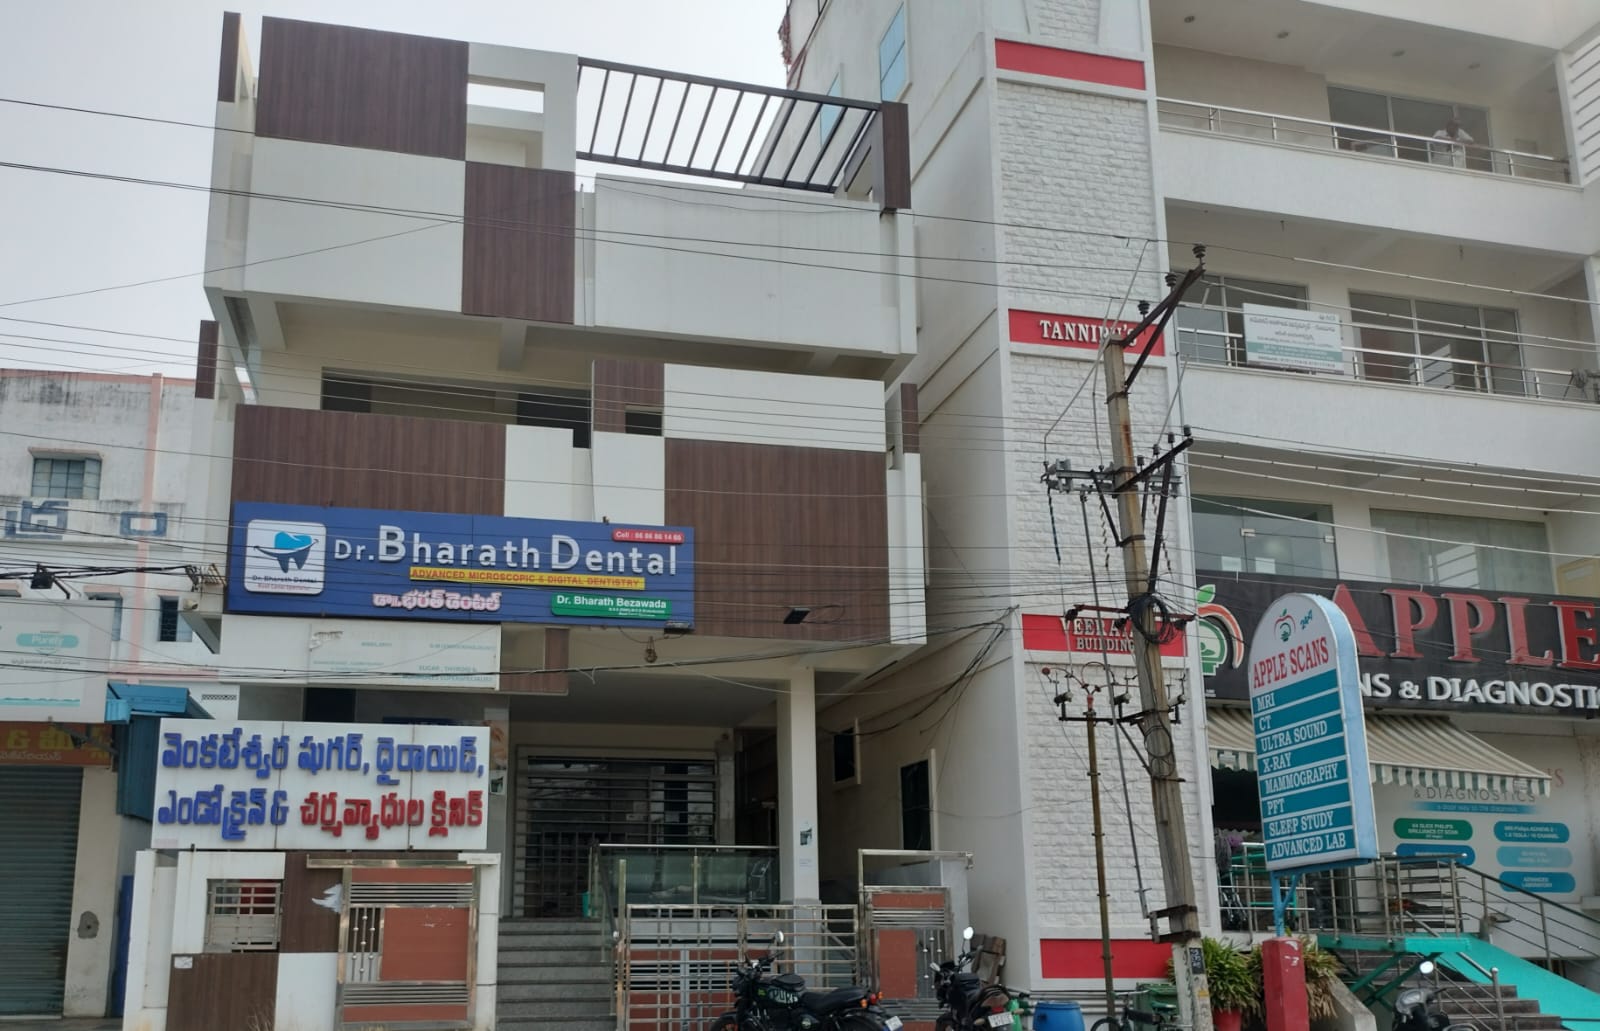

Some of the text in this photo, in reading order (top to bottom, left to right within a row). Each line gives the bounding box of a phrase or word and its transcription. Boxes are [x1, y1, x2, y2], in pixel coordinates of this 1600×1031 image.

[334, 525, 677, 575] Dr. Bharath Dental
[411, 569, 465, 579] ADVANCED
[468, 572, 535, 583] MICROSCOPIC
[547, 575, 584, 585] DIGITAL
[587, 577, 640, 588] DENTISTRY
[556, 594, 667, 609] Dr. Bharath Bezawada
[1332, 583, 1600, 670] APPLE
[1253, 636, 1329, 689] APPLE SCANS
[1256, 692, 1276, 711] MRI
[1398, 680, 1422, 699] &
[1426, 675, 1600, 710] DIAGNOSTI
[1259, 715, 1272, 731] CT
[1261, 720, 1328, 752] ULTRA SOUND
[162, 727, 290, 779] వెంకటేశ్వర
[298, 733, 370, 775] షుగర్,
[1262, 752, 1292, 773] X-RAY
[1265, 763, 1338, 794] MAMMOGRAPHY
[300, 791, 425, 840] చర్మవ్యాధుల
[428, 790, 484, 837] క్లినిక్
[1267, 798, 1285, 815] PFT
[1269, 811, 1334, 837] SLEEP STUDY
[1271, 832, 1346, 859] ADVANCED LAB
